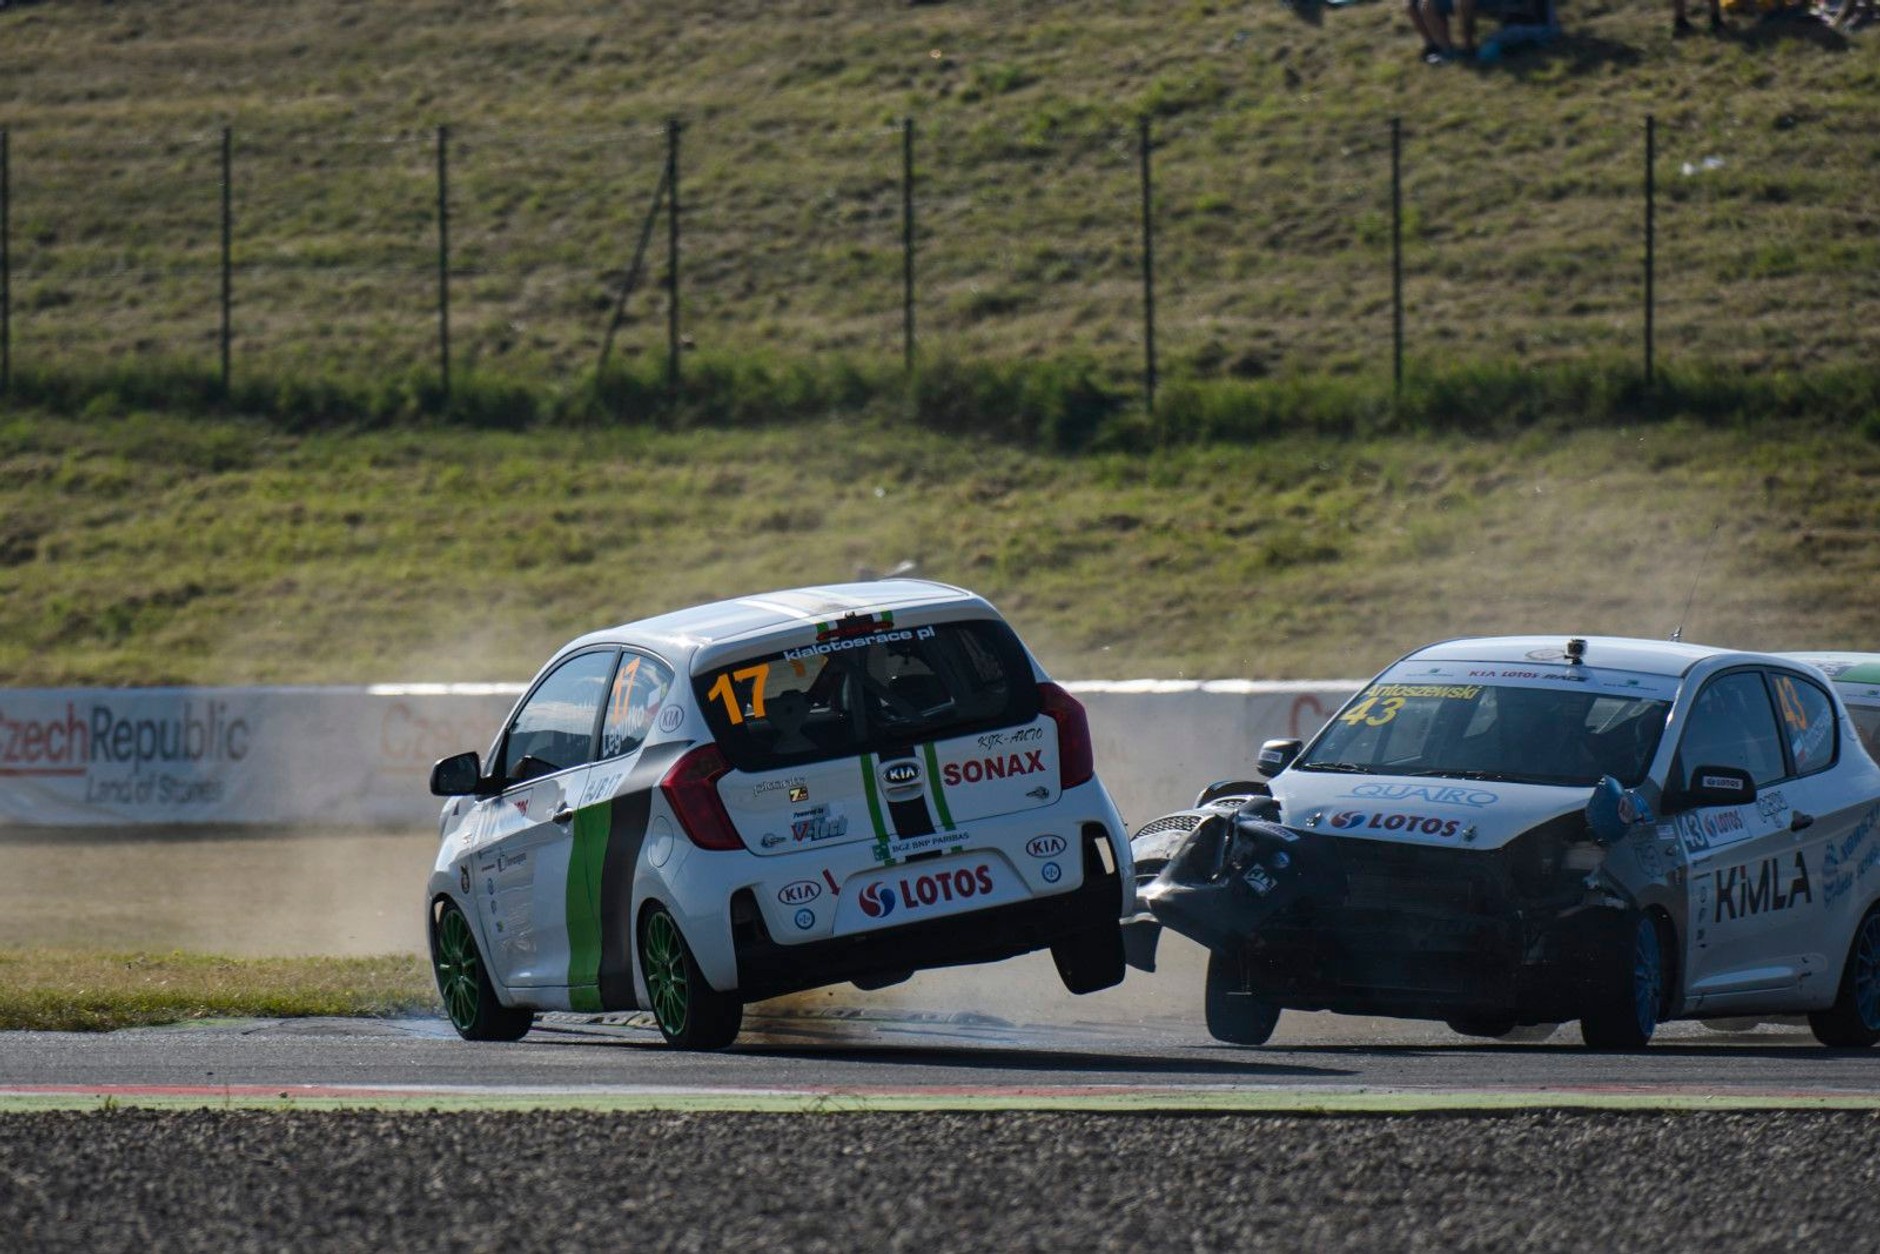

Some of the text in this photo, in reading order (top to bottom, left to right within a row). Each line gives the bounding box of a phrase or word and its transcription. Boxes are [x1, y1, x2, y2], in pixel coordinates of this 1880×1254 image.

[708, 663, 770, 726] 17
[1775, 677, 1807, 731] 43
[660, 709, 681, 726] KIA
[1339, 697, 1407, 726] 43
[889, 766, 916, 781] KIA
[943, 749, 1046, 786] SONAX
[1368, 812, 1461, 837] LOTOS
[1681, 812, 1705, 848] 43
[1715, 810, 1743, 834] LOTOS
[1032, 840, 1061, 854] KIA
[785, 885, 816, 901] KIA
[899, 865, 994, 909] LOTOS
